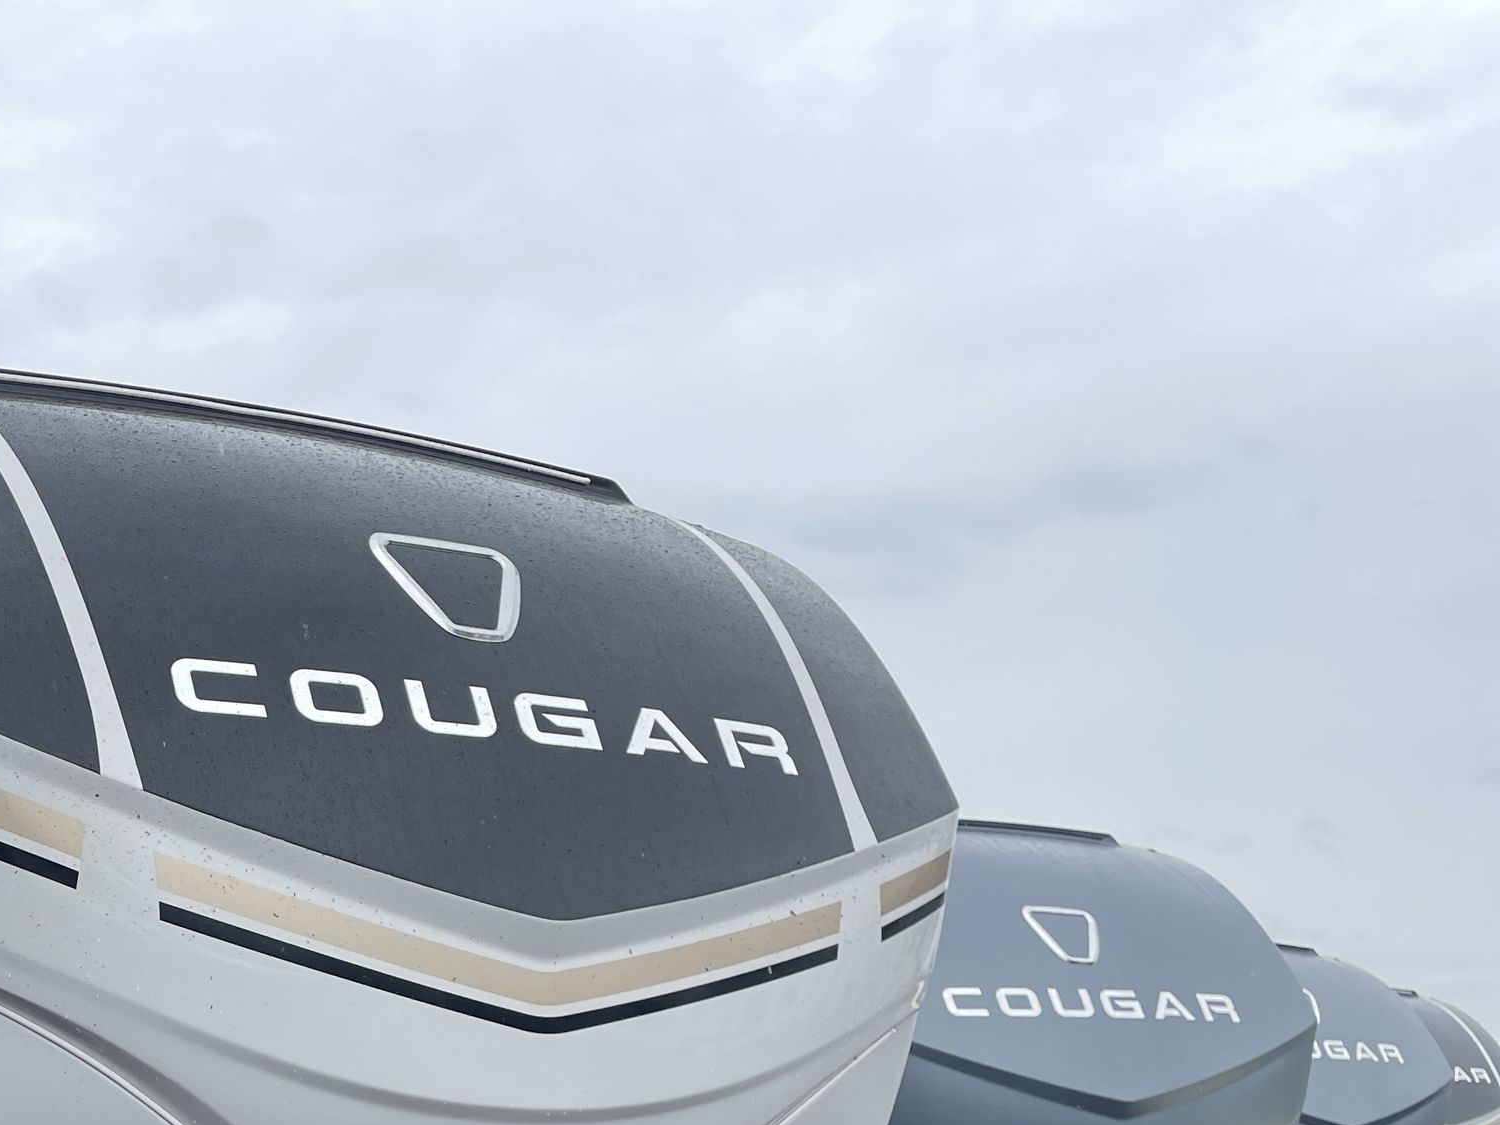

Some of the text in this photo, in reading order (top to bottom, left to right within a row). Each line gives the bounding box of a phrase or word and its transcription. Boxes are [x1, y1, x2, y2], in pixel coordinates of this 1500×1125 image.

[170, 657, 799, 776] COUGAR
[942, 986, 1241, 1024] COUGAR
[1312, 1039, 1405, 1064] GAR
